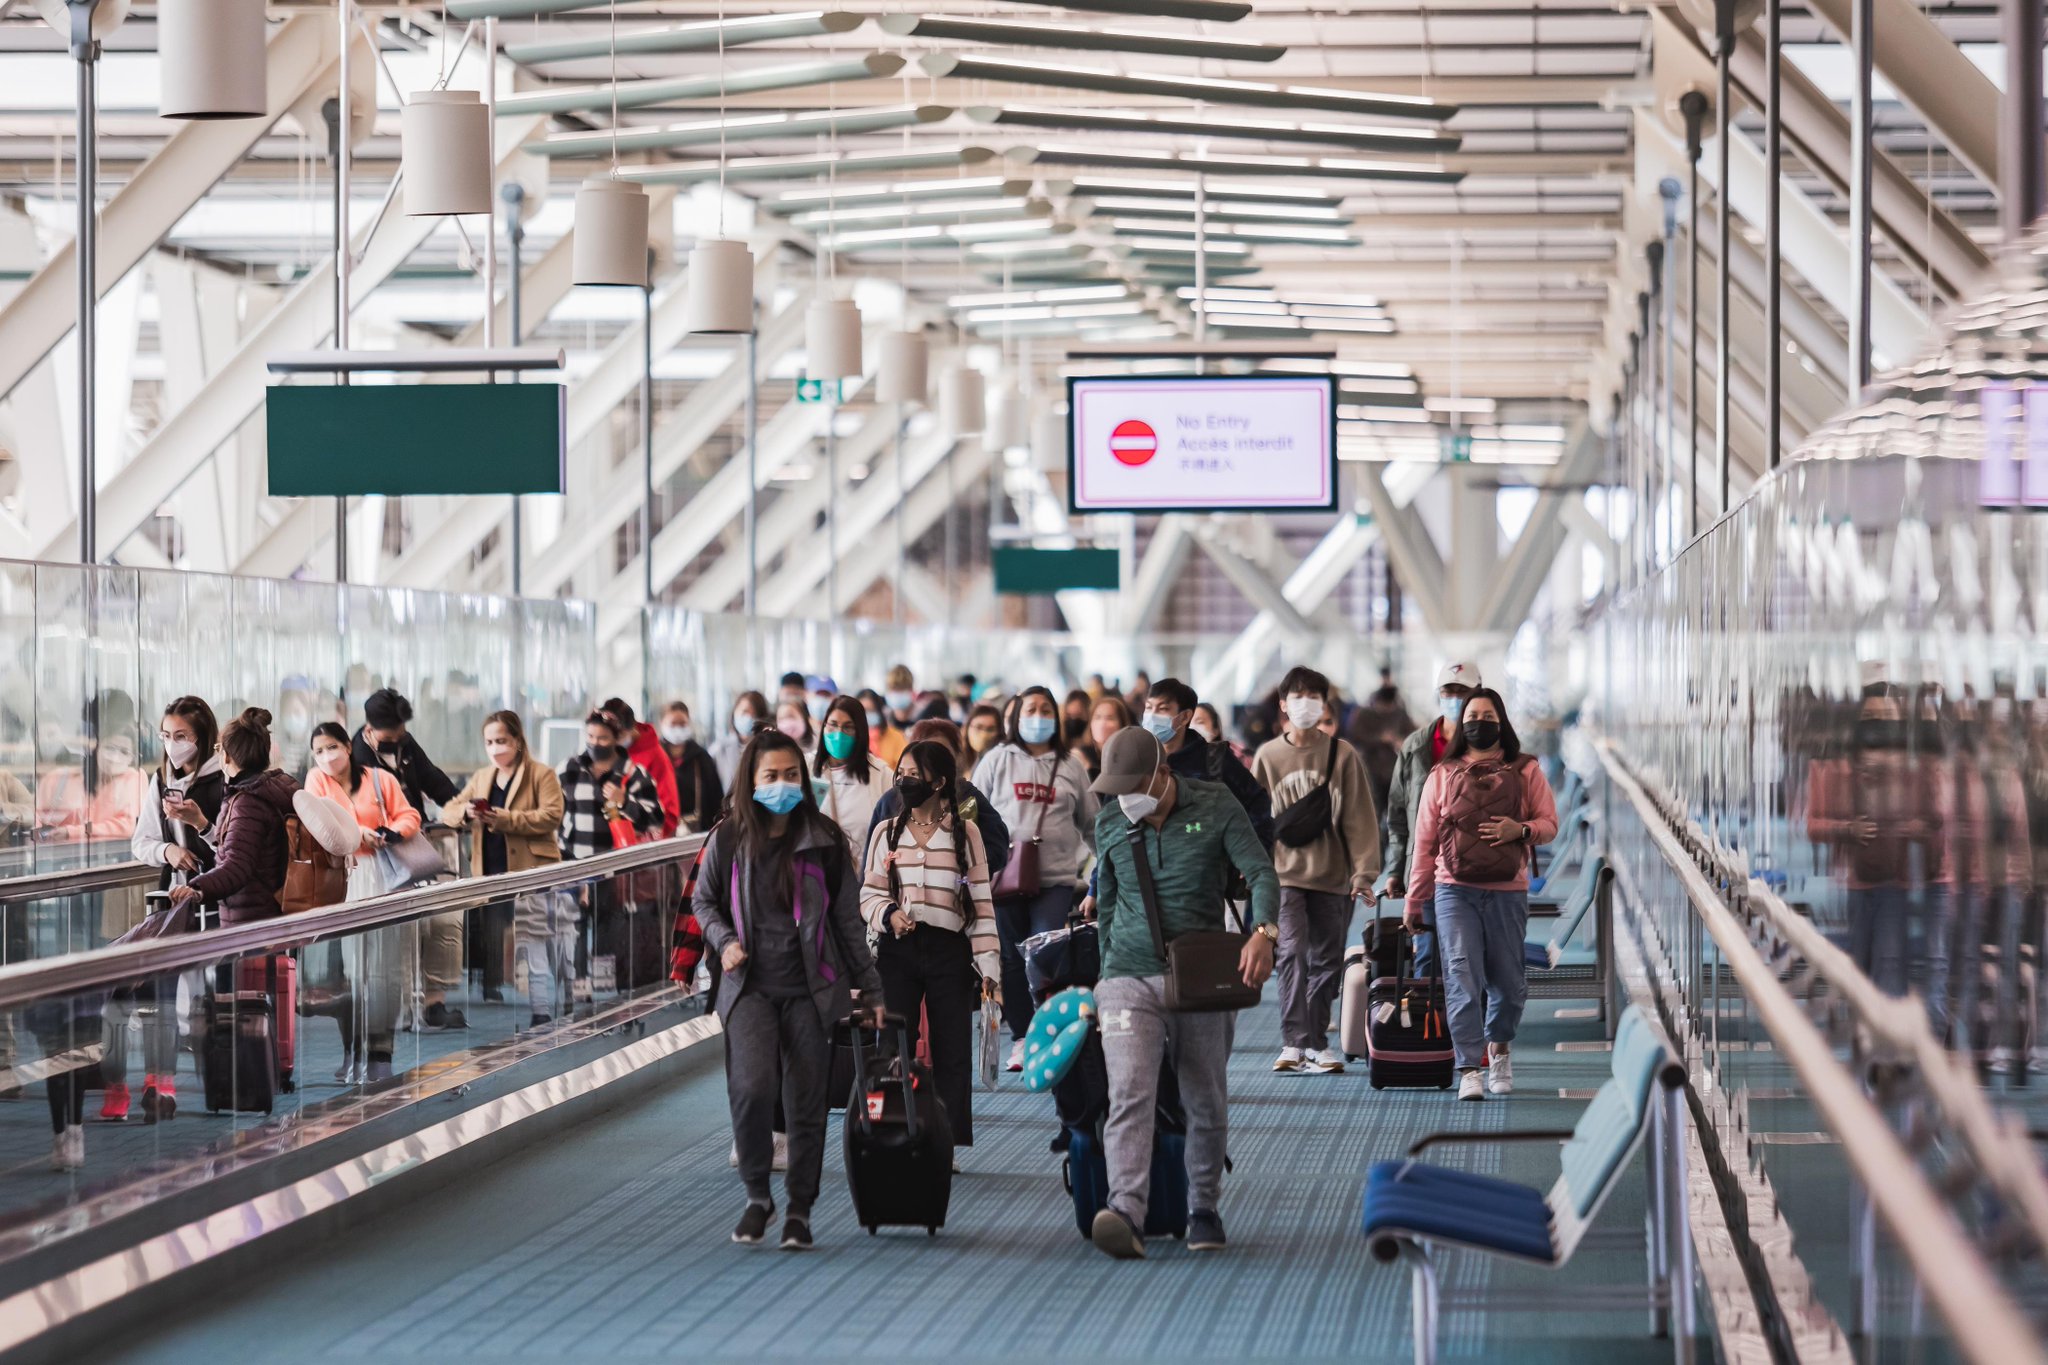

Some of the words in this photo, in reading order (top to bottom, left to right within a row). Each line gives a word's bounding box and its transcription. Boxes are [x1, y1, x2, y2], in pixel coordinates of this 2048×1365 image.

[1176, 415, 1200, 430] No
[1206, 415, 1250, 433] Entry
[1234, 435, 1295, 451] interdit
[1017, 786, 1052, 799] Levi
